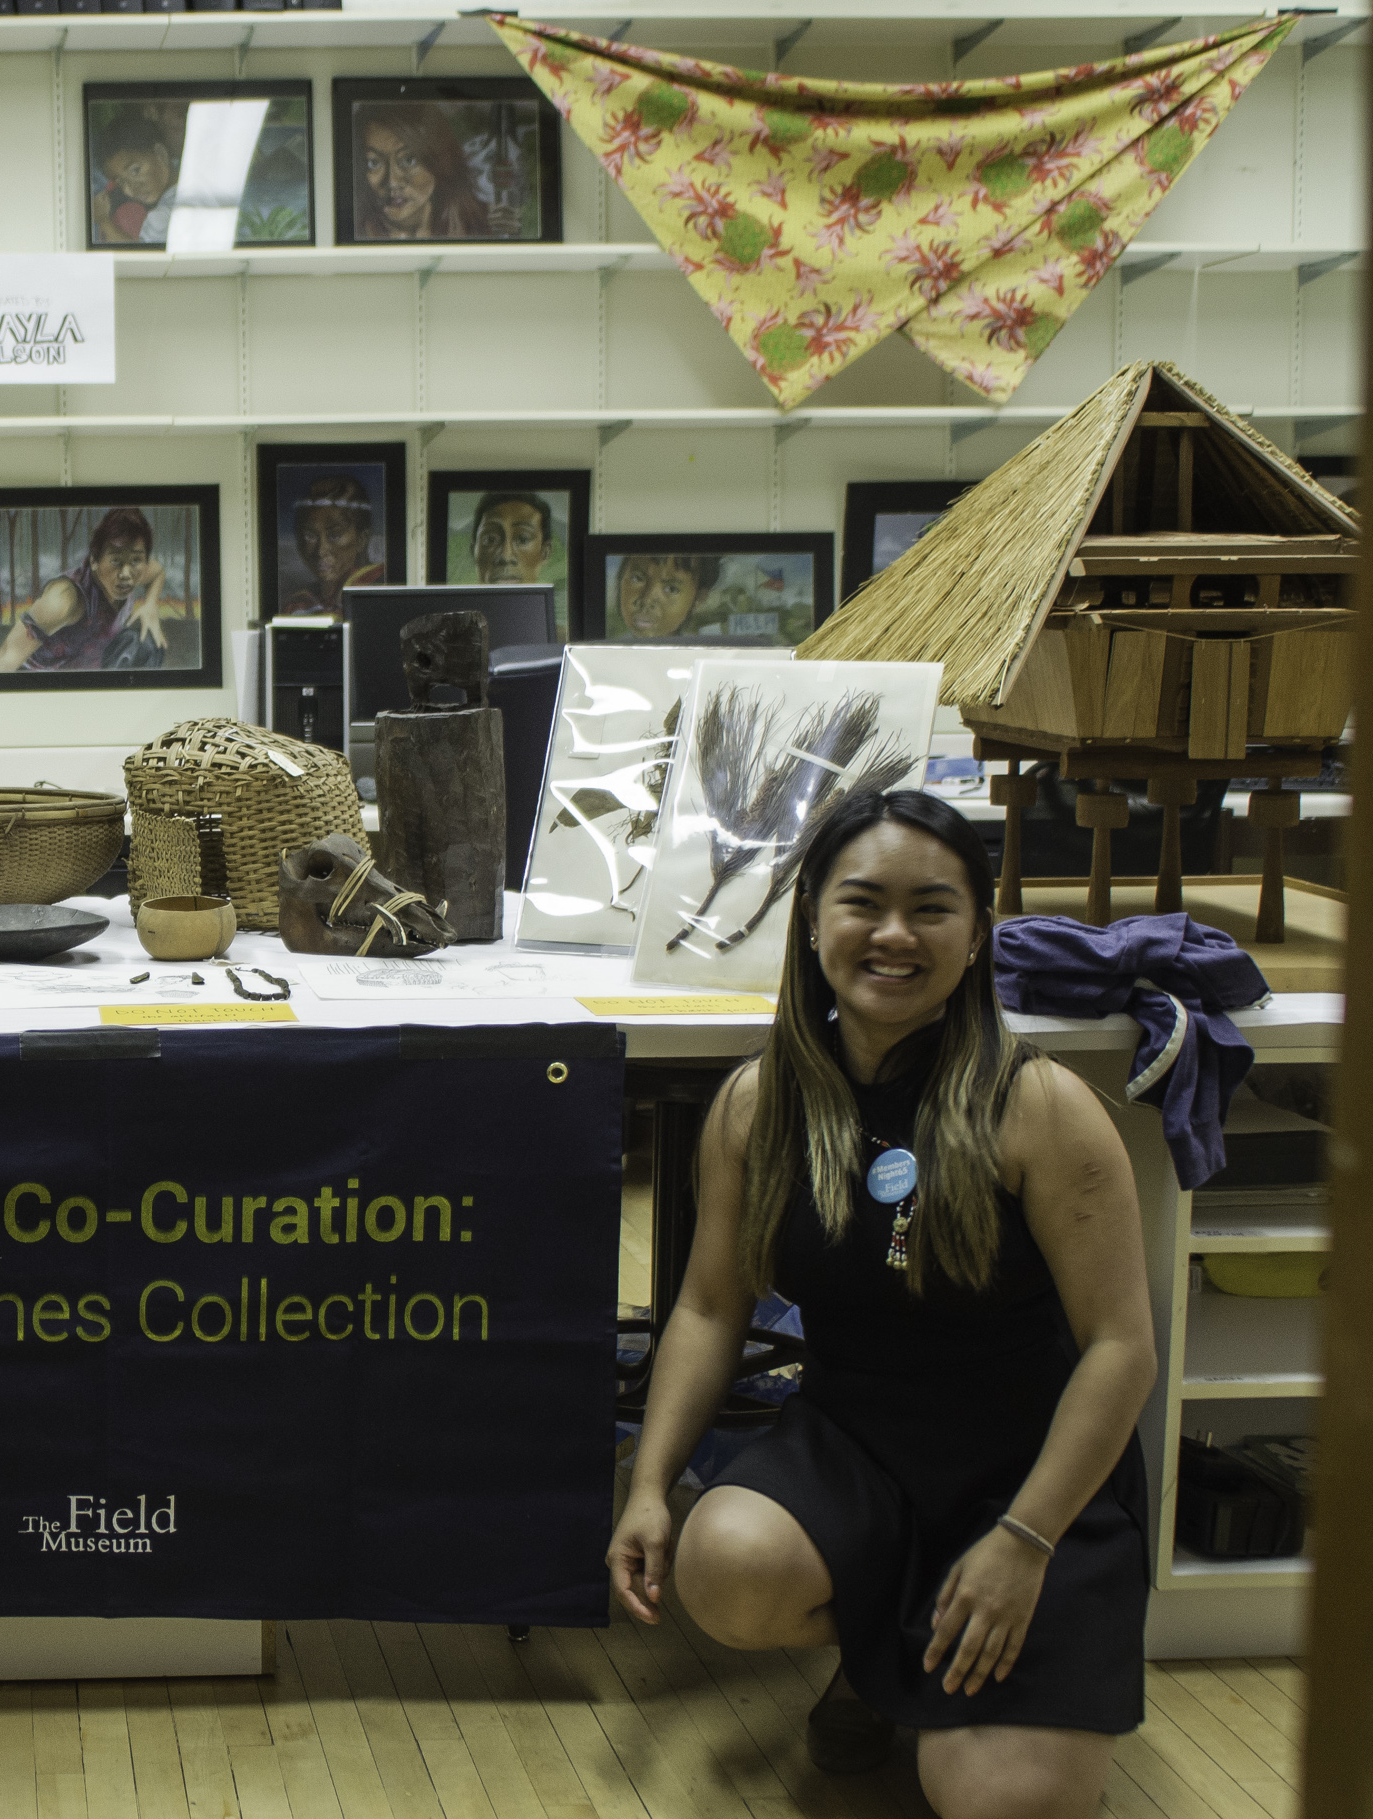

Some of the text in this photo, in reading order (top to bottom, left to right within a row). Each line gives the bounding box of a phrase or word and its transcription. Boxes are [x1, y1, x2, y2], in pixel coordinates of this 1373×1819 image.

[3, 1178, 474, 1245] Co-Curation:
[139, 1275, 489, 1343] Collection
[22, 1494, 177, 1534] The Field
[41, 1531, 153, 1553] Museum
